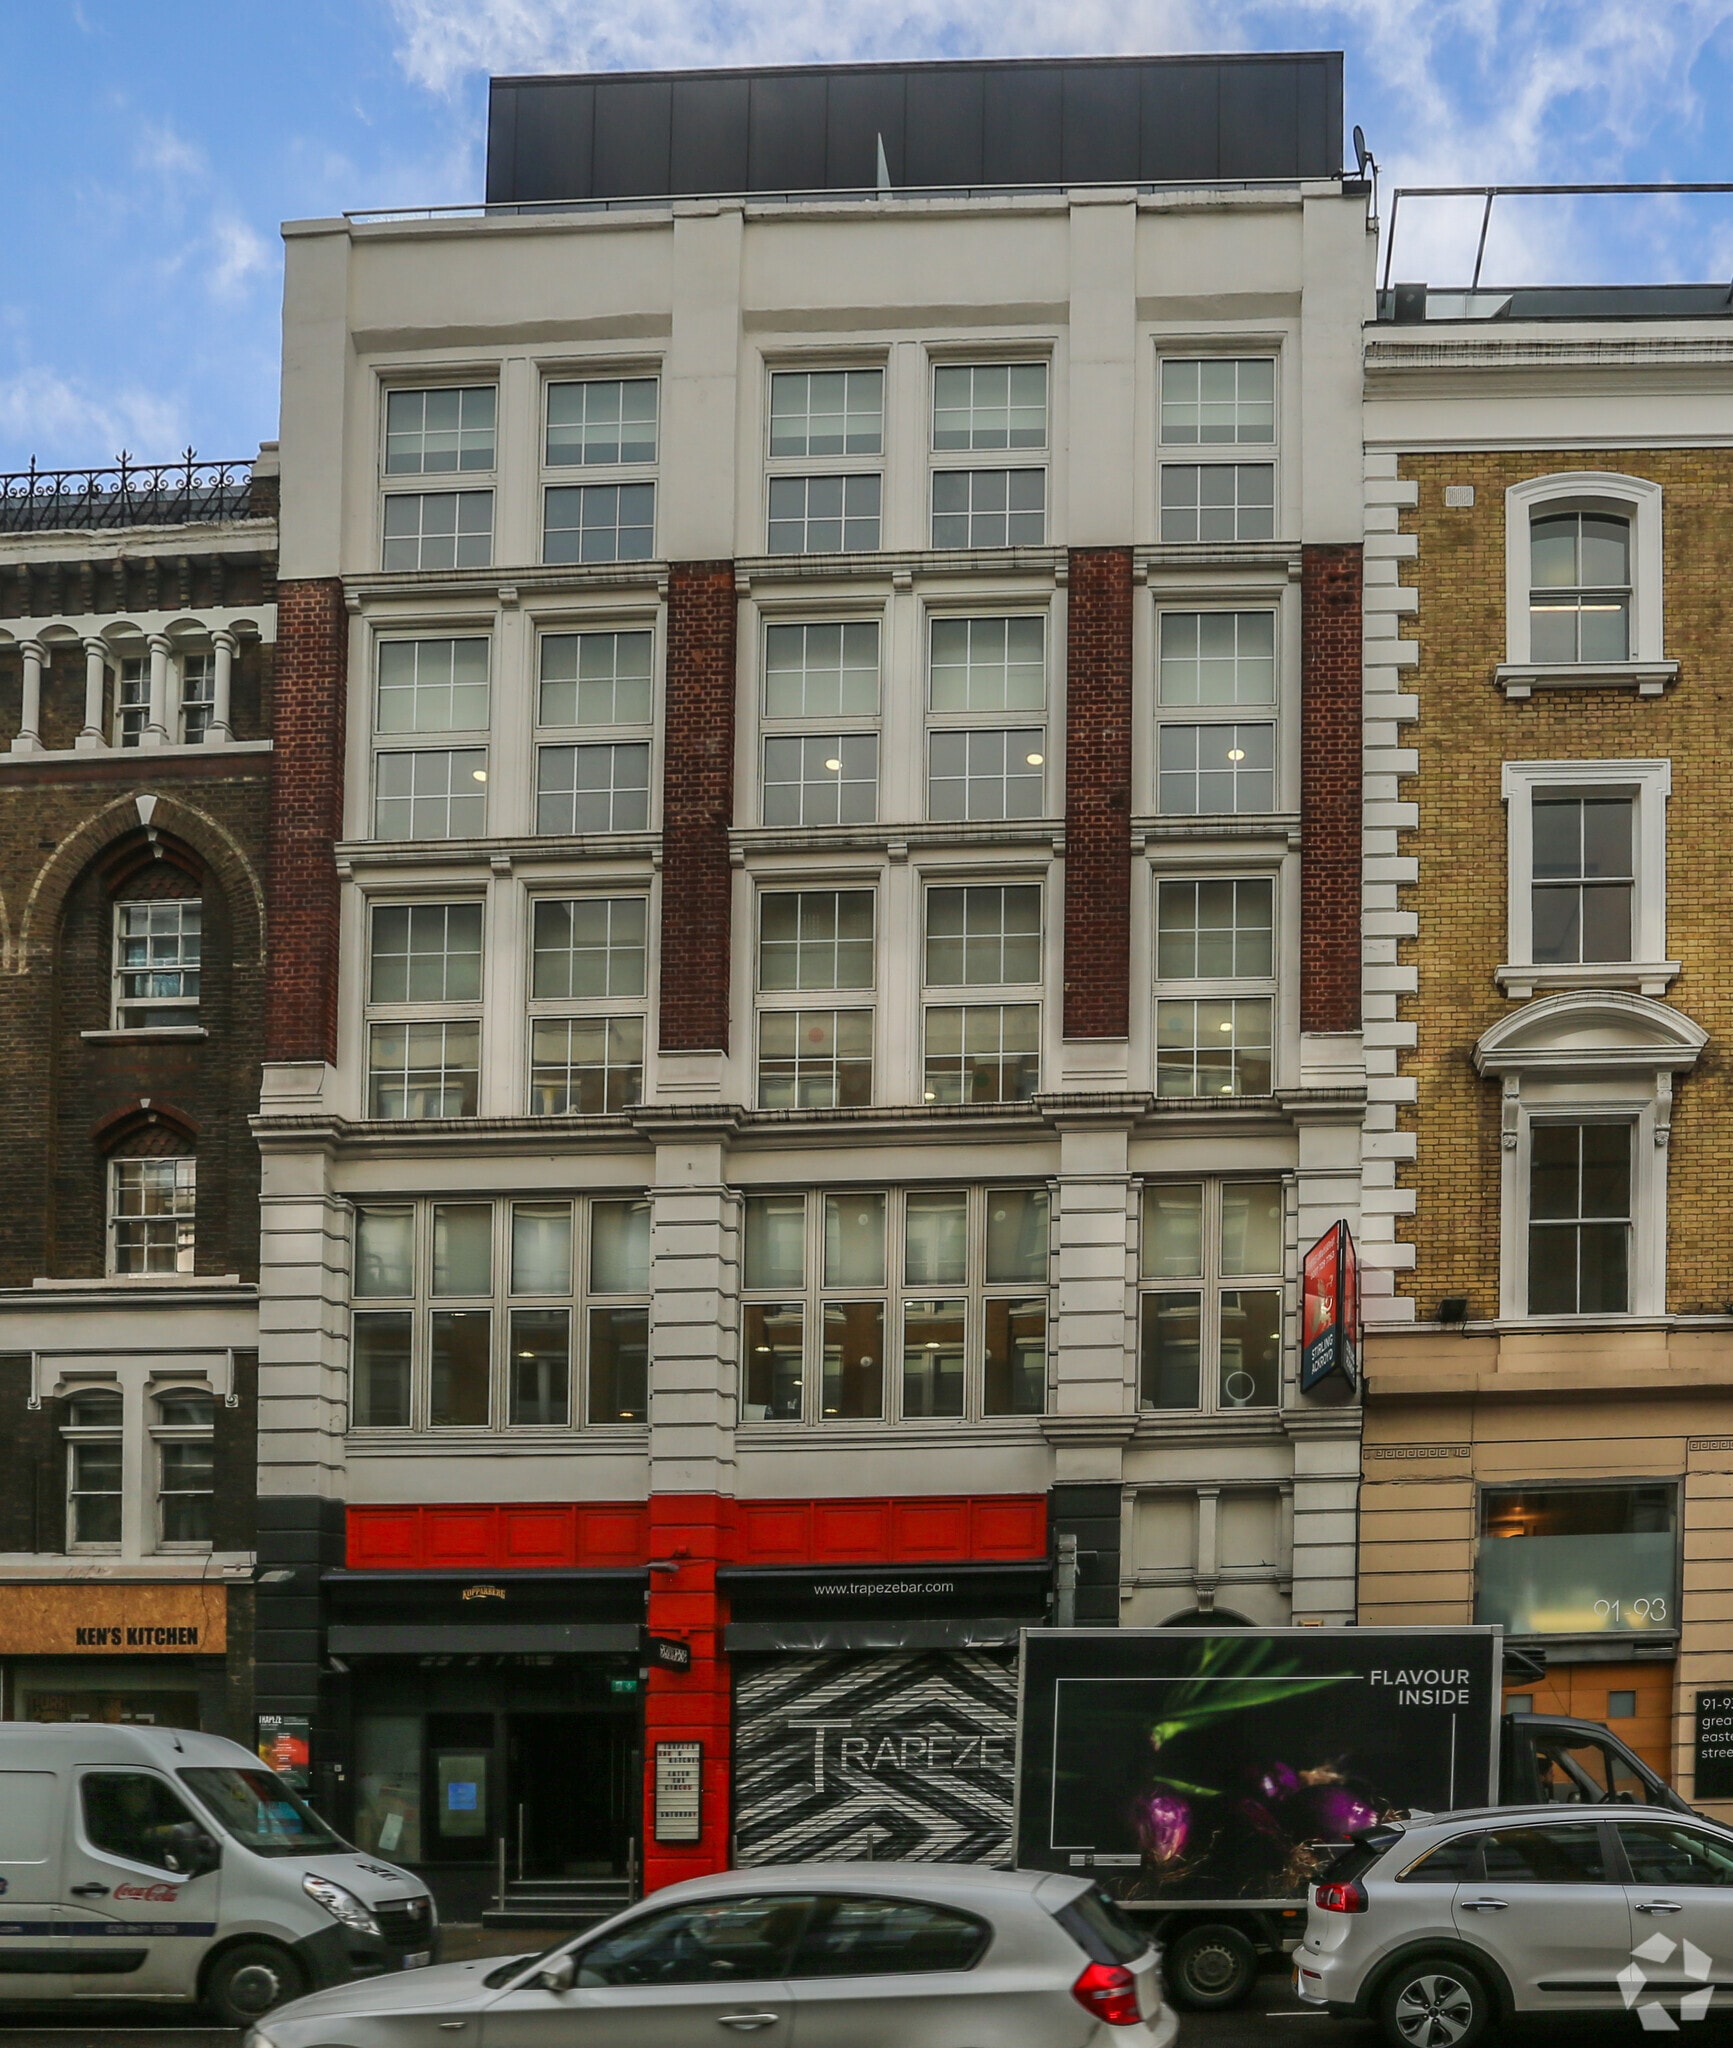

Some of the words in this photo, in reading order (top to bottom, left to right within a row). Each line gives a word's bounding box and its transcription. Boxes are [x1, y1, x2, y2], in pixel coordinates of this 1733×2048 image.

[1311, 1333, 1334, 1361] STIRLING
[1311, 1348, 1334, 1375] ACKROYD
[813, 1581, 954, 1596] www.trapezebar.com
[1593, 1598, 1667, 1622] 91-93
[76, 1627, 122, 1646] KEN'S
[126, 1626, 199, 1646] KITCHEN
[1369, 1669, 1470, 1686] FLAVOUR
[1398, 1689, 1470, 1705] INSIDE
[1702, 1697, 1733, 1710] 91-9
[1702, 1716, 1733, 1730] grea
